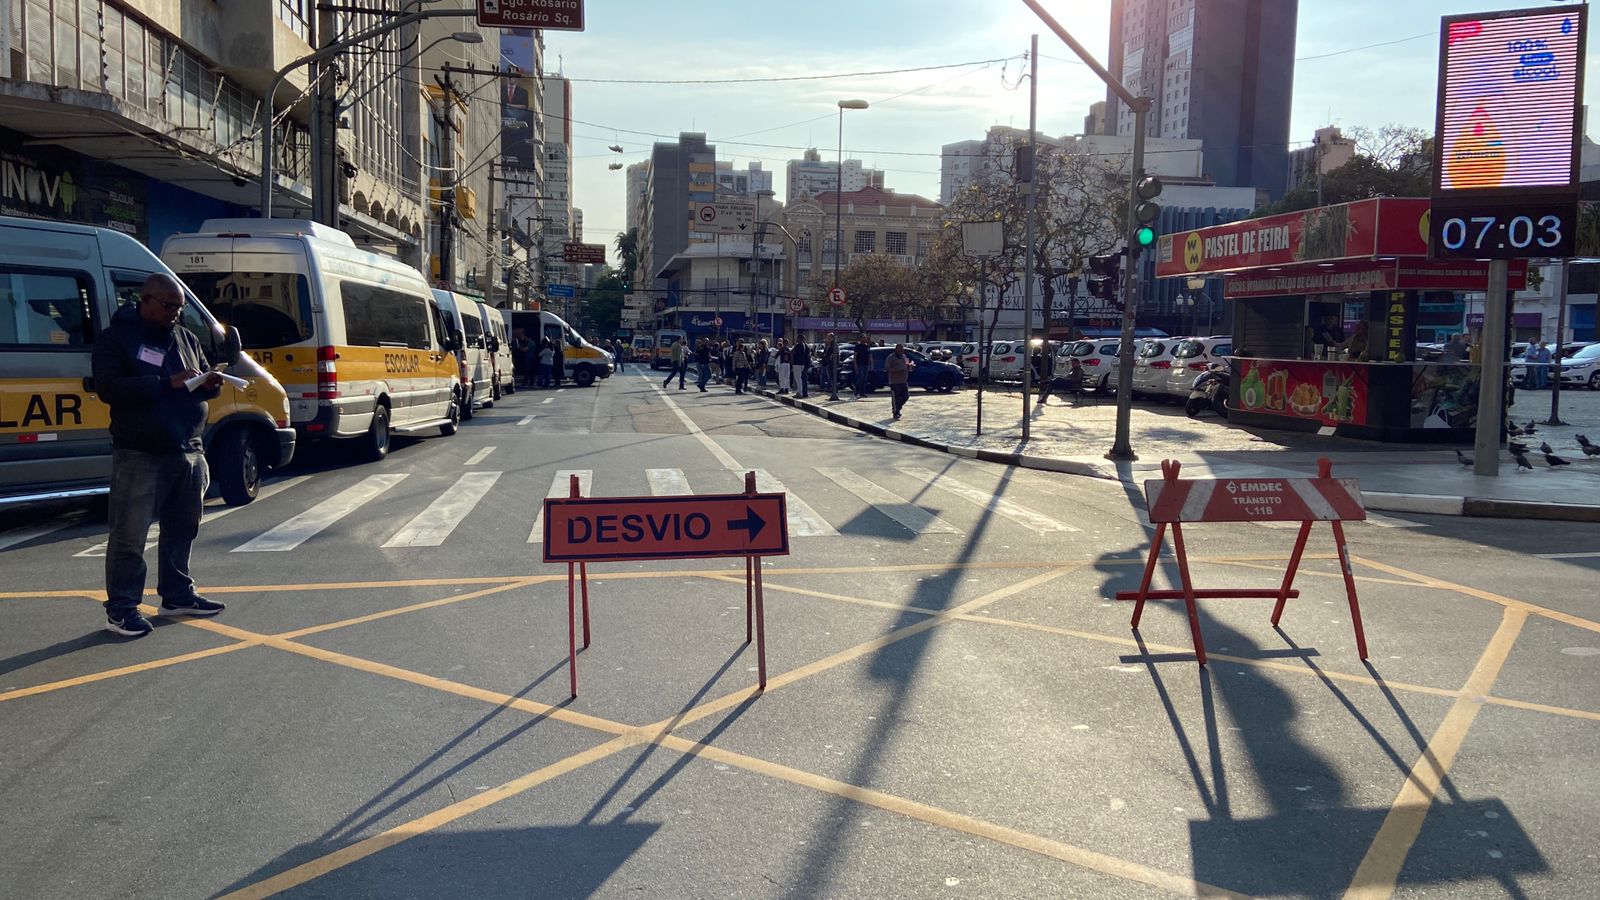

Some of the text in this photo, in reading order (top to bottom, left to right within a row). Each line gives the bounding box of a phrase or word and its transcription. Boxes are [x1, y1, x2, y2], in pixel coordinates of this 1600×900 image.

[502, 10, 573, 25] Rosário Sq.
[1204, 225, 1290, 259] PASTEL DE FEIRA
[1442, 215, 1562, 250] 07:03
[190, 256, 204, 264] 181
[1277, 277, 1296, 291] CALDO
[1297, 277, 1304, 289] DE
[1304, 276, 1324, 289] CANA
[1350, 272, 1359, 285] DE
[1360, 270, 1381, 284] COCO
[384, 353, 420, 373] ESCOLAR
[1240, 482, 1283, 493] EMDEC
[1253, 507, 1273, 515] 118
[567, 512, 711, 544] DESVIO
